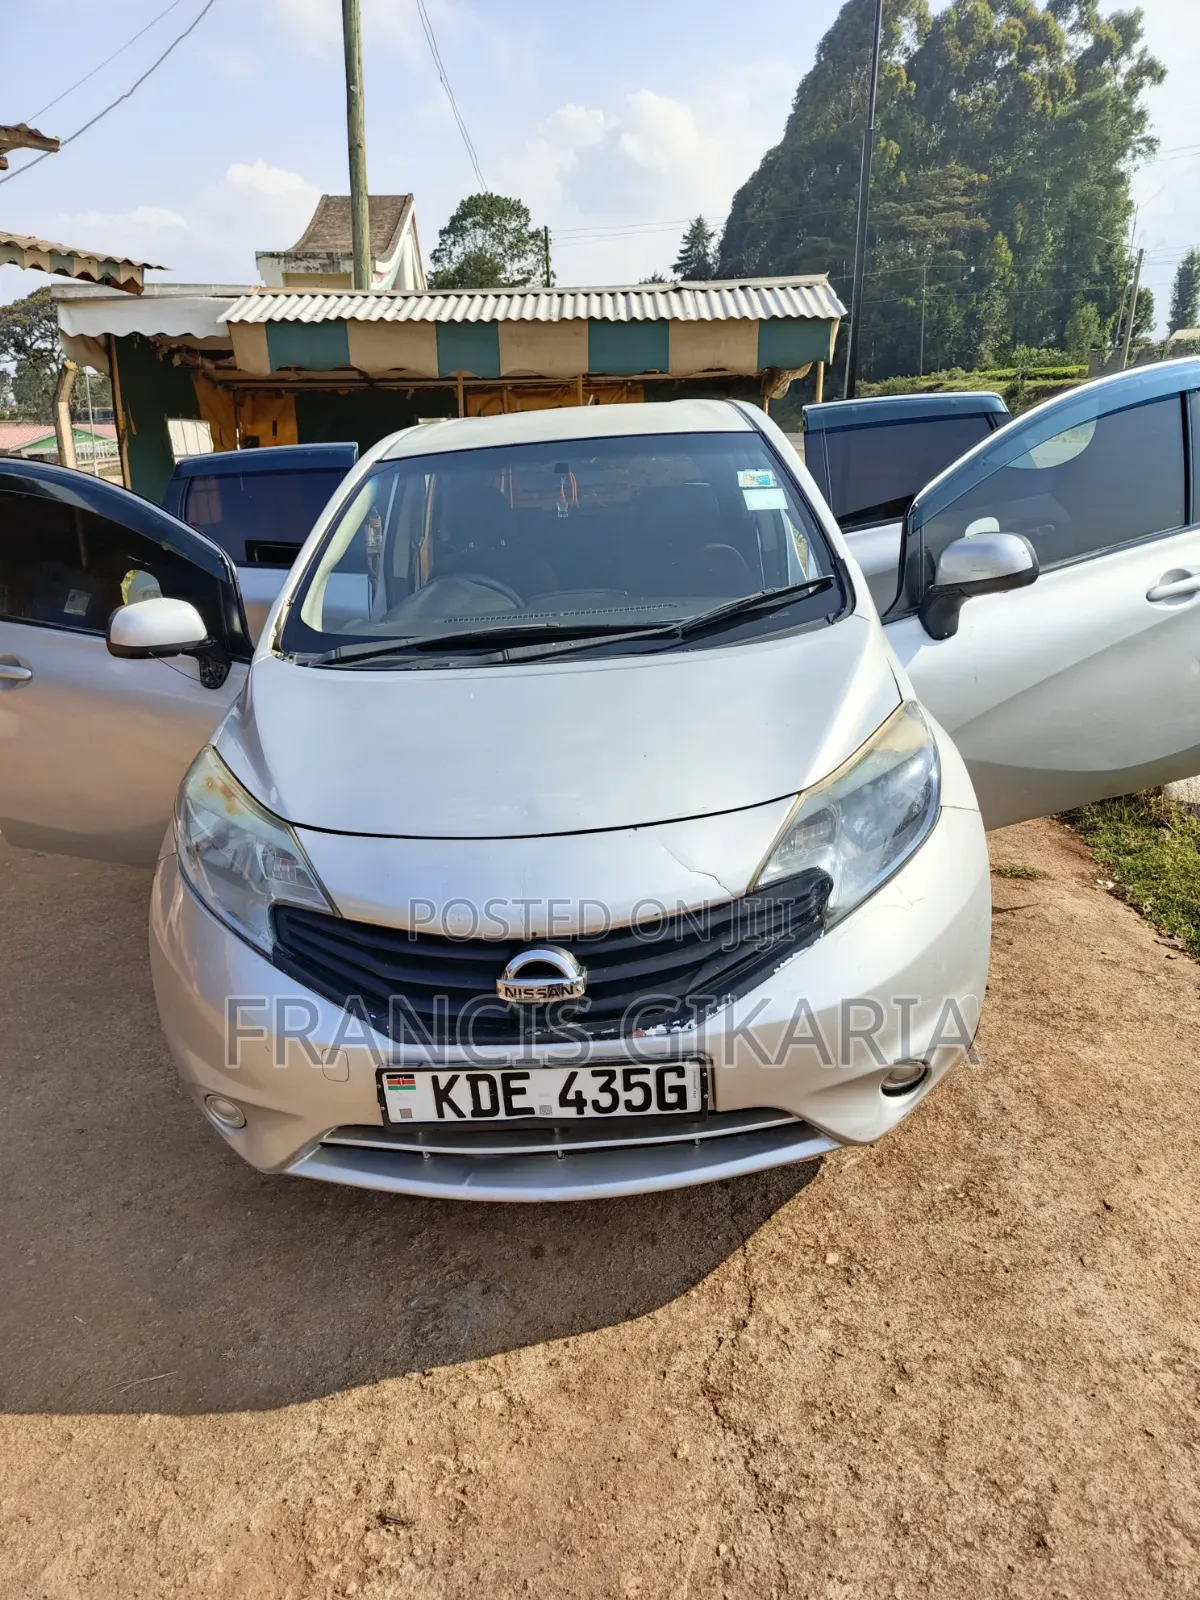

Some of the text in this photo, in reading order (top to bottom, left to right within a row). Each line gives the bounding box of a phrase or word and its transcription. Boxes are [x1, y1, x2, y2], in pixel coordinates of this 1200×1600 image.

[504, 985, 574, 999] NISSAN
[431, 1072, 535, 1119] KDE
[558, 1065, 688, 1116] 435G
